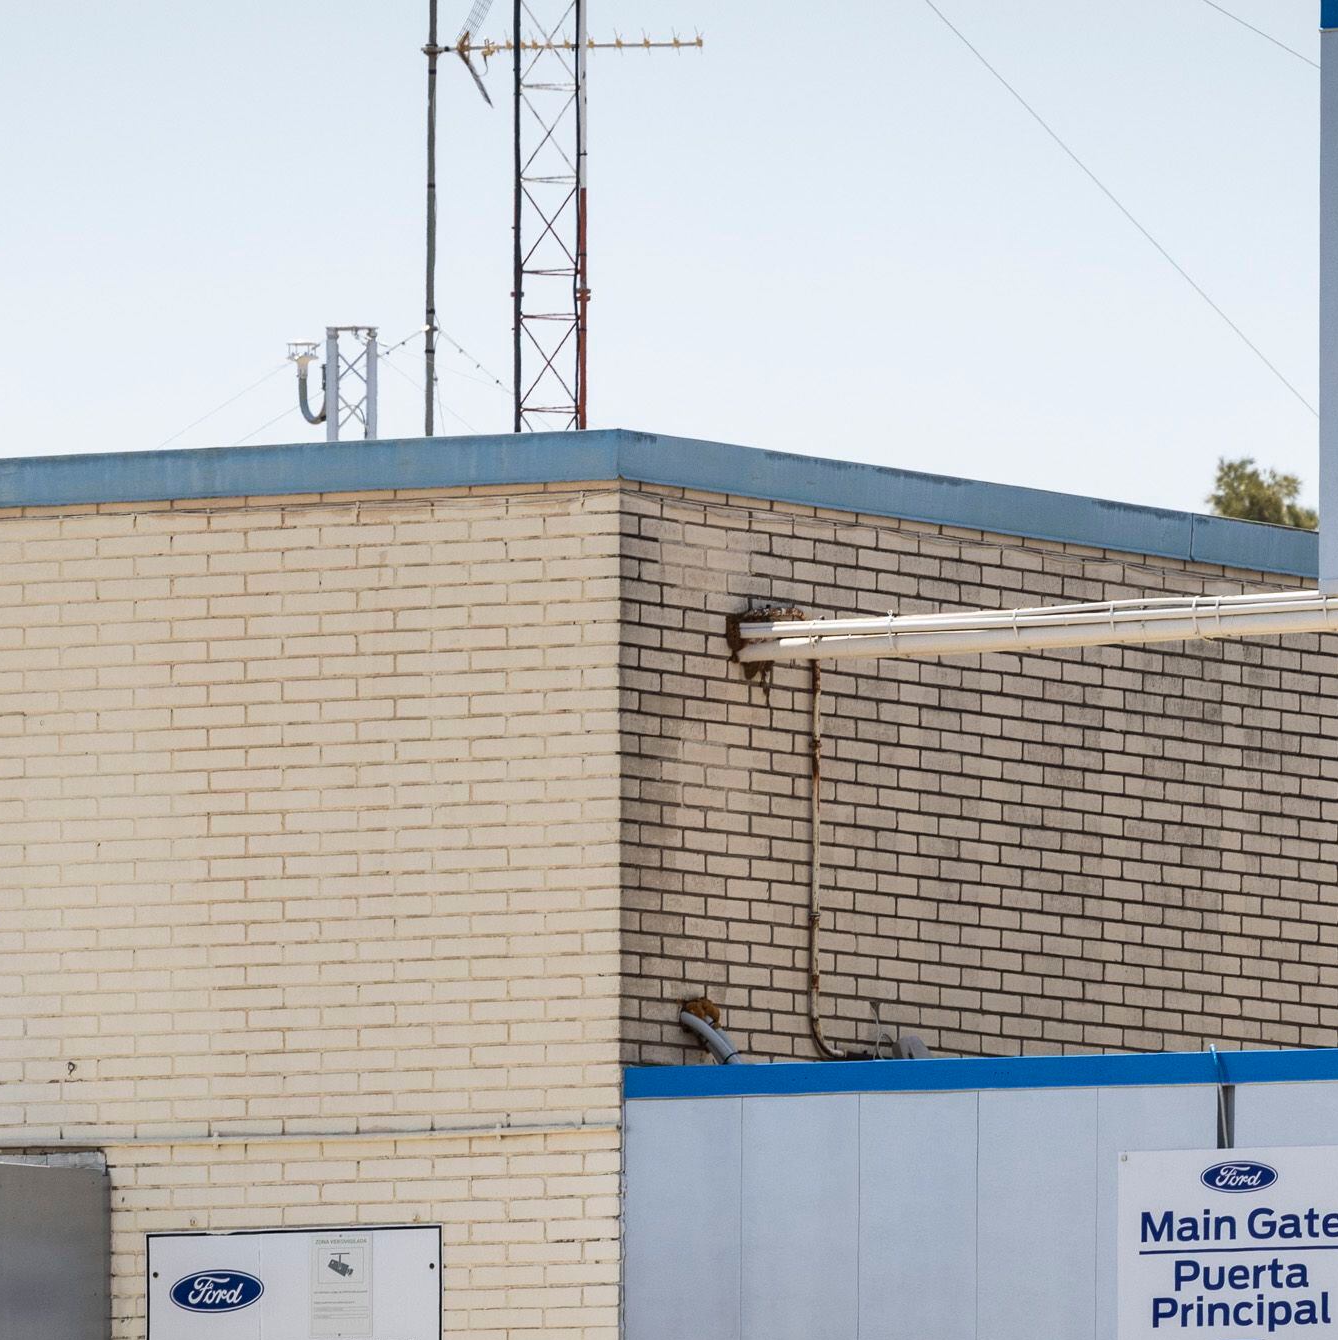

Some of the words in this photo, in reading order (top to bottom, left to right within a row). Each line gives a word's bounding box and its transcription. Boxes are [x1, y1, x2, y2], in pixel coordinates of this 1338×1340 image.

[1214, 1165, 1262, 1188] Ford
[1140, 1208, 1237, 1243] Main
[188, 1276, 244, 1306] Ford
[1174, 1258, 1310, 1292] Puerta
[1152, 1291, 1331, 1333] Principal
